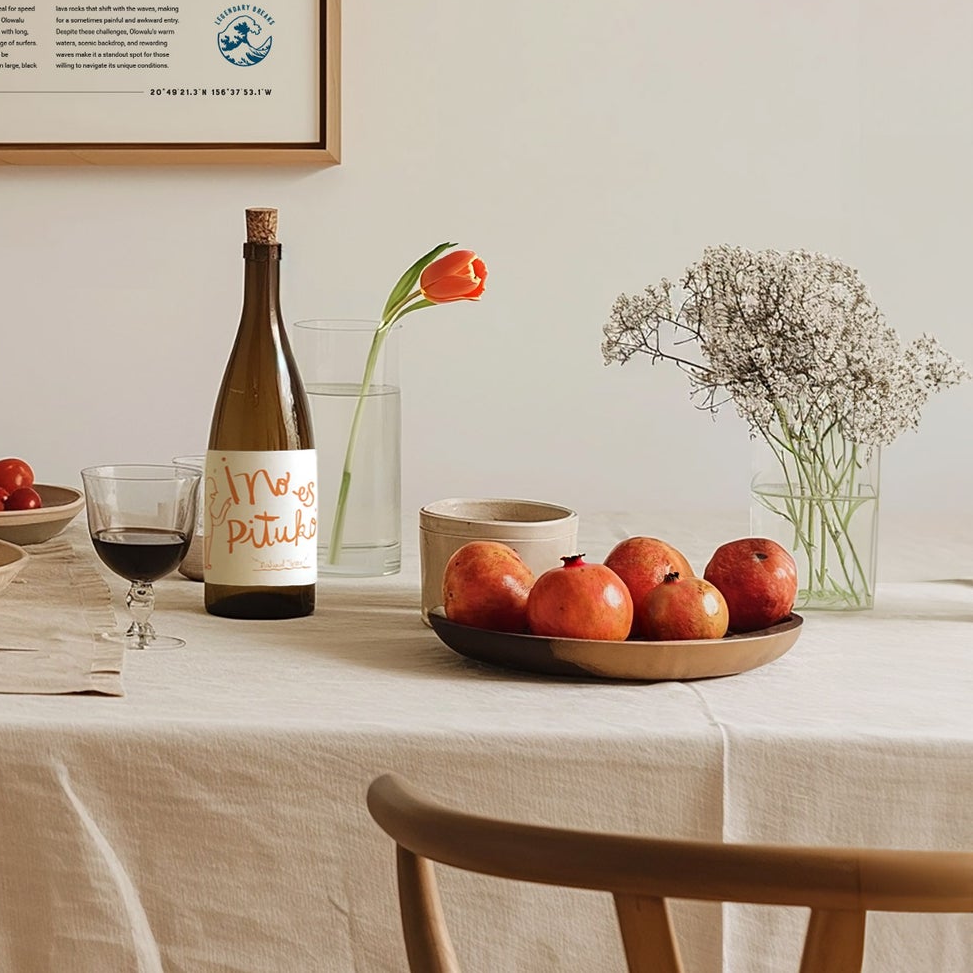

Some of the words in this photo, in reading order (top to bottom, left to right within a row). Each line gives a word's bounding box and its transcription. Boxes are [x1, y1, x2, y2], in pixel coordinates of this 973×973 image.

[214, 4, 250, 26] LEGENDARY
[252, 6, 276, 26] BREAKS
[292, 481, 315, 508] es
